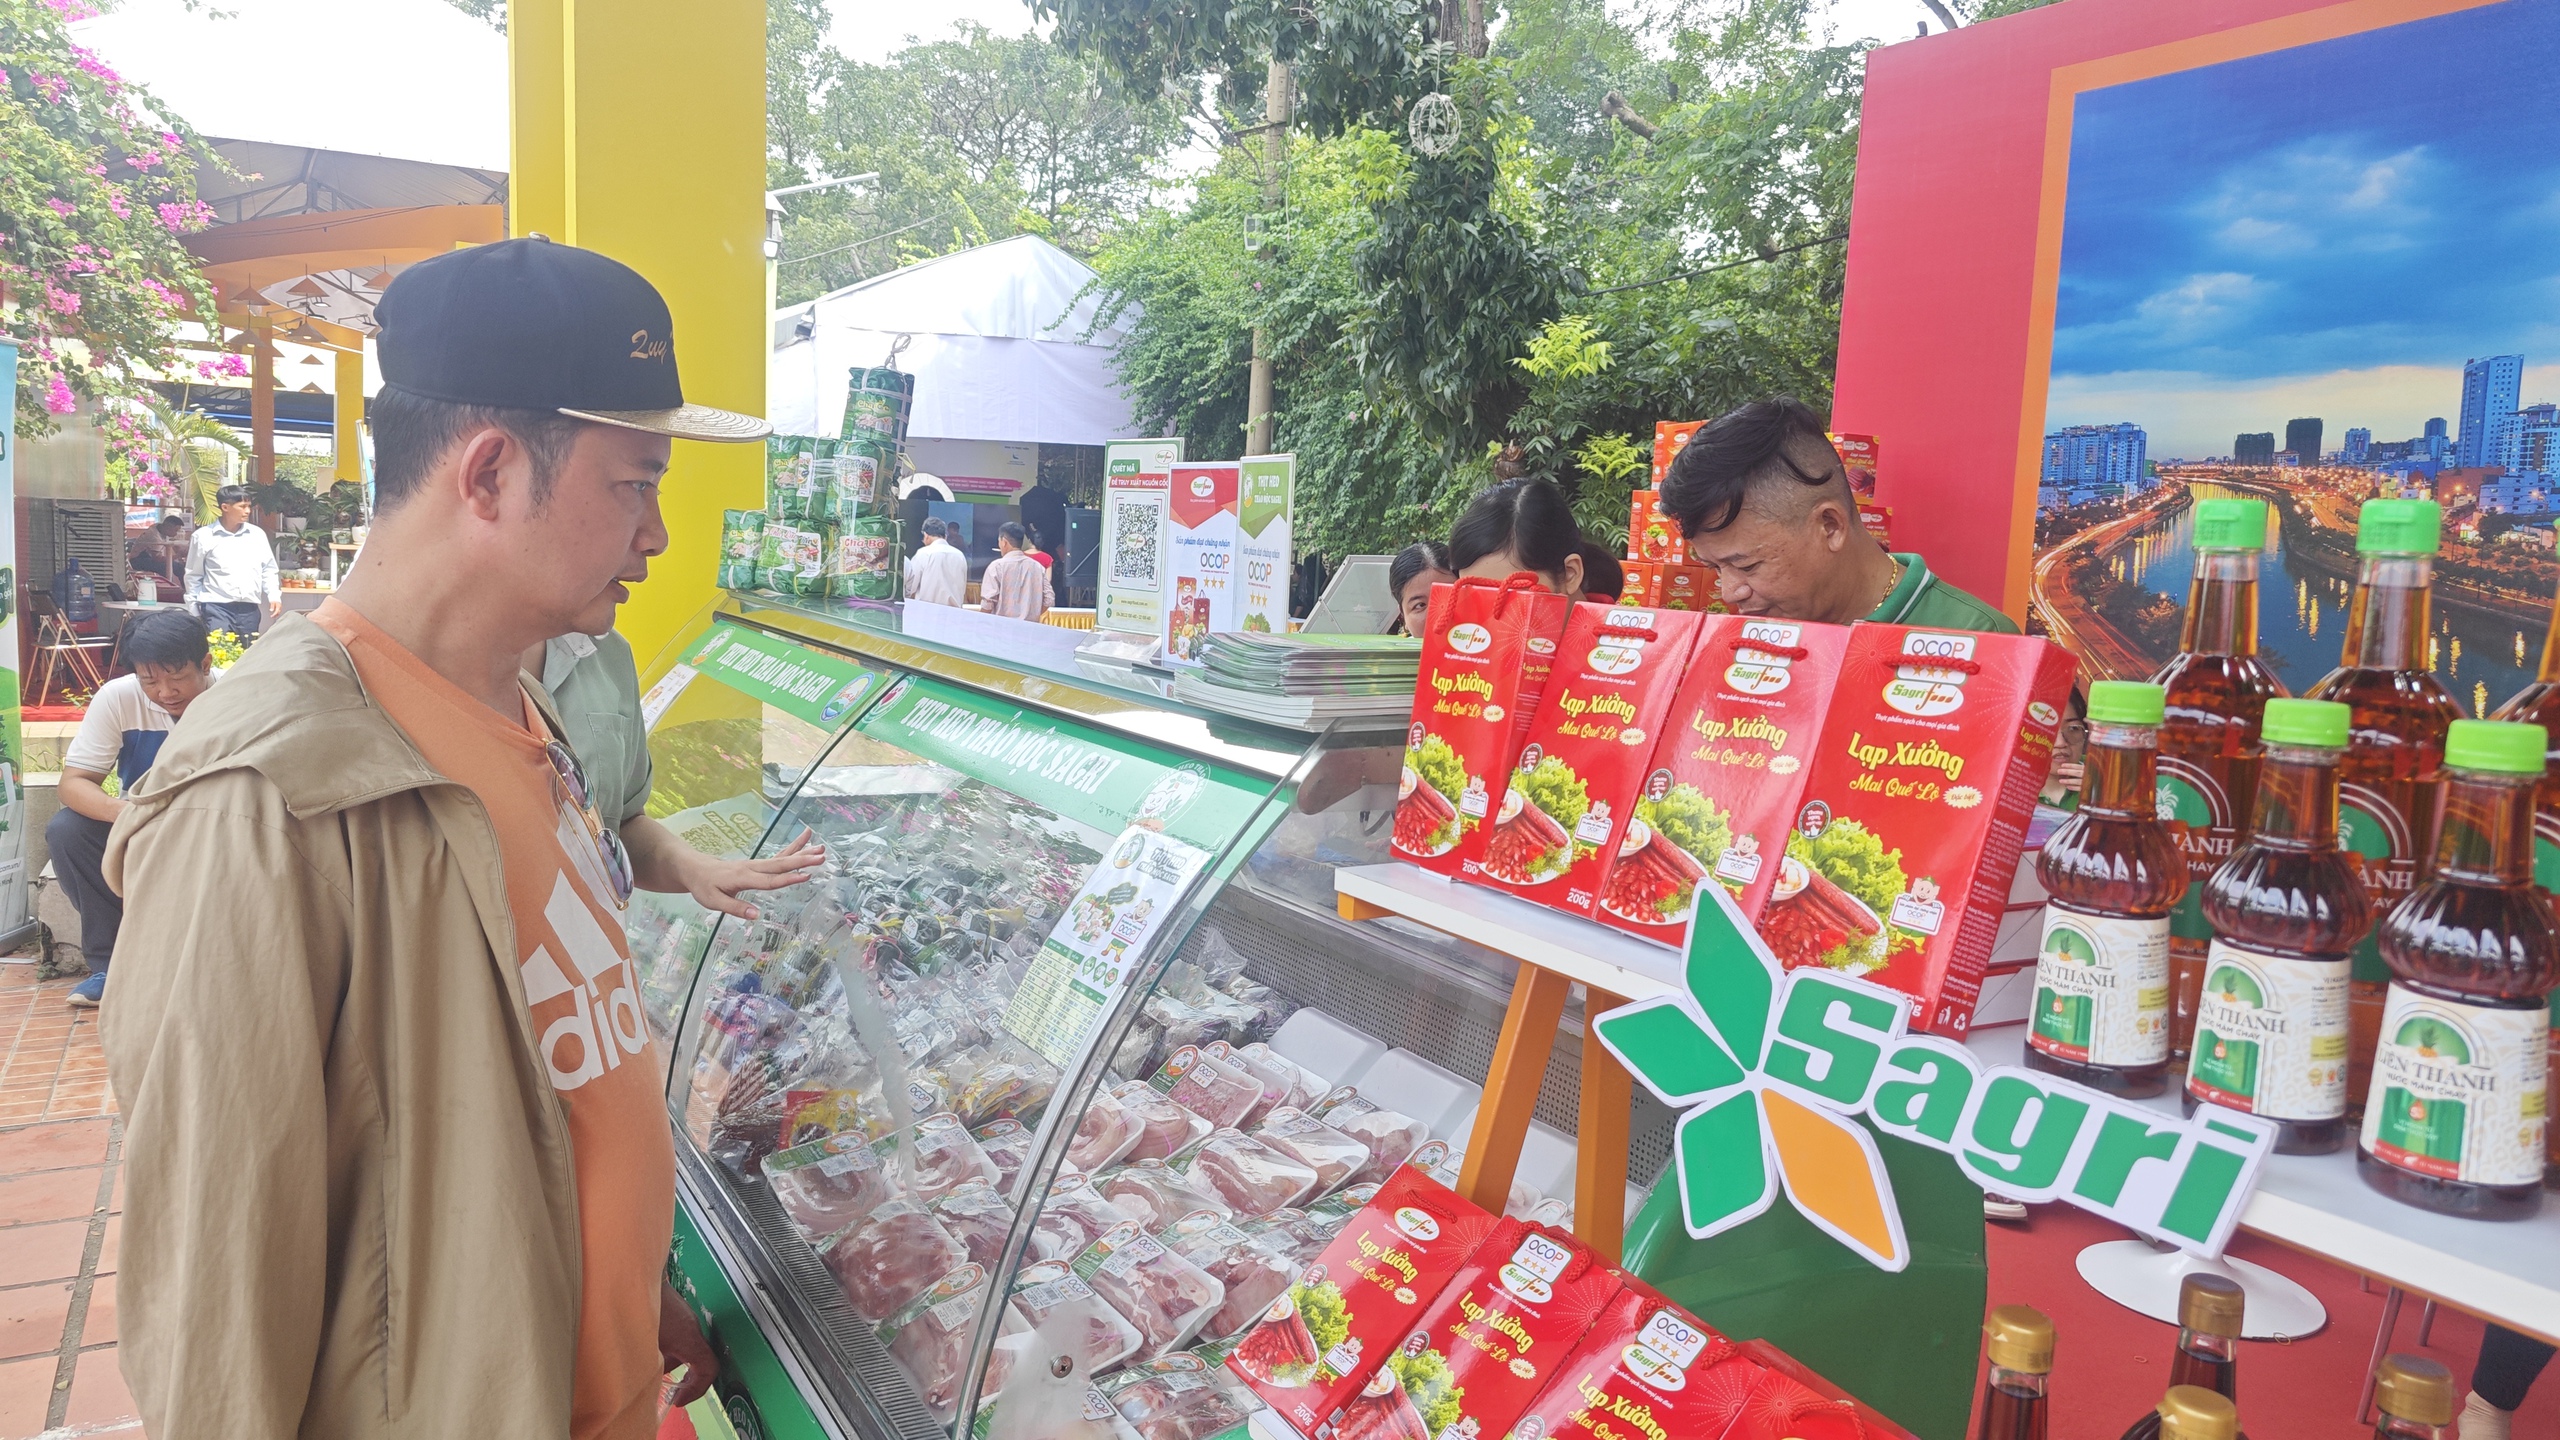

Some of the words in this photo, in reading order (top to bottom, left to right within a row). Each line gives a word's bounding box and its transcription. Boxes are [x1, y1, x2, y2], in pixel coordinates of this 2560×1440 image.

[1269, 475, 1280, 488] HEO
[1200, 552, 1230, 570] OCOP
[1248, 561, 1272, 582] OCOP
[1611, 614, 1648, 627] OCOP
[1748, 627, 1792, 644] OCOP
[1912, 639, 1965, 657] OCOP
[789, 670, 836, 703] SAGRI
[1431, 667, 1452, 696] Lạp
[1452, 670, 1494, 702] Xưởng
[1732, 666, 1786, 690] Sagrifood
[1433, 699, 1451, 713] Mai
[1452, 701, 1467, 716] Quế
[1468, 703, 1481, 718] Lộ
[1559, 688, 1586, 718] Lạp
[1585, 692, 1637, 725] Xưởng
[1892, 684, 1958, 710] Sagrifood
[1557, 720, 1580, 735] Mai
[1581, 723, 1602, 738] Quế
[1601, 725, 1617, 741] Lộ
[1692, 709, 1726, 742] Lạp
[1725, 715, 1788, 751] Xưởng
[1875, 713, 1887, 722] Thực
[1887, 715, 1902, 725] phẩm
[1903, 718, 1915, 726] sạch
[1926, 721, 1937, 729] mọi
[1938, 722, 1947, 730] gia
[1947, 722, 1960, 731] đình
[900, 697, 952, 737] THỊT
[937, 707, 978, 742] HEO
[960, 711, 1022, 757] THẢO
[999, 726, 1056, 776] MỘC
[1039, 749, 1121, 794] SAGRI
[1691, 745, 1718, 762] Mai
[1721, 749, 1746, 766] Quế
[1745, 753, 1765, 769] Lộ
[1848, 731, 1888, 770] Lạp
[1888, 739, 1965, 782] Xưởng
[1849, 773, 1883, 793] Mai
[1885, 778, 1917, 798] Quế
[1916, 782, 1941, 802] Lộ
[2172, 830, 2235, 856] ÀNH
[2187, 860, 2215, 872] HAY
[2357, 865, 2414, 889] ÀNH
[1566, 892, 1590, 909] 200g
[2374, 898, 2394, 908] AY
[1118, 924, 1136, 938] OCOP
[2055, 965, 2116, 988] THÀNH
[2072, 985, 2095, 995] CHAY
[539, 959, 650, 1091] did
[2218, 1006, 2286, 1034] THÀNH
[2236, 1029, 2260, 1040] CHAY
[1199, 1064, 1216, 1079] OCOP
[1227, 1057, 1245, 1069] OCOP
[2412, 1061, 2496, 1093] THÀNH
[909, 1087, 931, 1102] OCOP
[2438, 1087, 2468, 1099] CHAY
[1763, 977, 2259, 1245] Sagri
[1138, 1238, 1159, 1253] OCOP
[1356, 1230, 1378, 1256] Lạp
[1377, 1245, 1419, 1284] Xưởng
[1528, 1239, 1564, 1263] OCOP
[1346, 1257, 1365, 1274] Mai
[1364, 1266, 1382, 1284] Quế
[1379, 1275, 1395, 1291] Lộ
[1505, 1268, 1550, 1298] Sagrifood
[1067, 1278, 1089, 1296] OCOP
[1459, 1291, 1486, 1322] Lạp
[1482, 1308, 1535, 1354] Xưởng
[1657, 1317, 1698, 1346] OCOP
[1449, 1322, 1473, 1341] Mai
[1471, 1333, 1494, 1352] Quế
[1490, 1345, 1509, 1363] Lộ
[1629, 1348, 1683, 1384] Sagrifood
[1086, 1393, 1110, 1414] OCOP
[1577, 1373, 1609, 1409] Lạp
[1605, 1395, 1667, 1440] Xưởng
[1293, 1405, 1313, 1426] 200g
[1567, 1409, 1596, 1430] Mai
